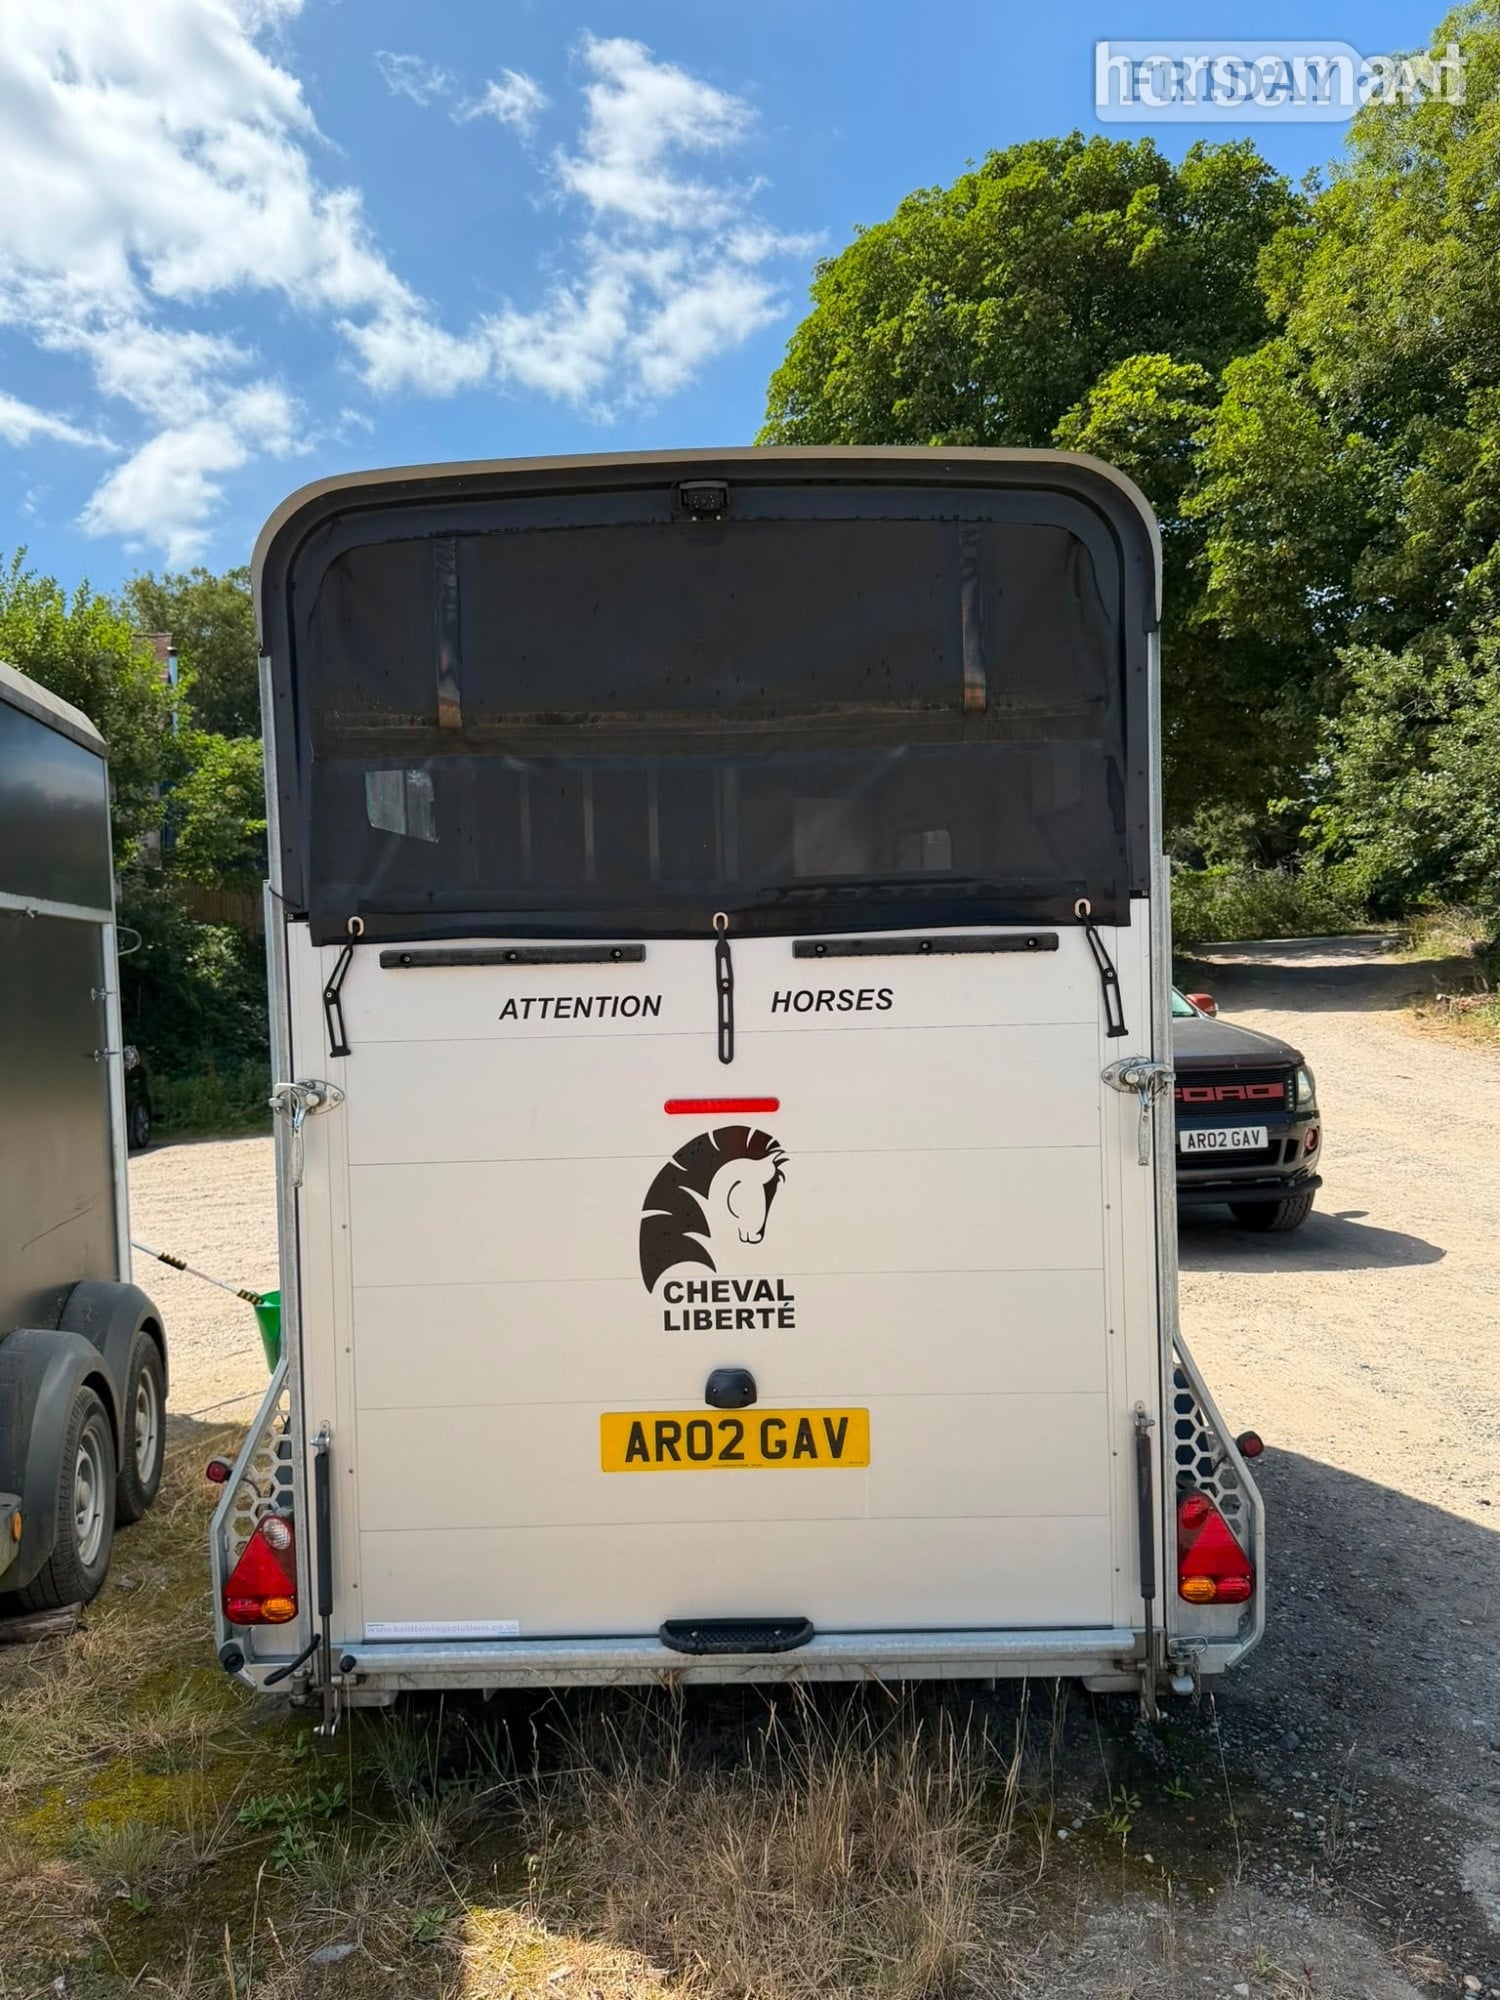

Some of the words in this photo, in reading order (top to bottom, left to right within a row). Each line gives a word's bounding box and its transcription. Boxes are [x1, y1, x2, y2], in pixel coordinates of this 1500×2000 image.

[499, 995, 662, 1020] ATTENTION
[771, 988, 894, 1013] HORSES
[1187, 1132, 1227, 1149] AR02
[1231, 1130, 1260, 1146] GAV
[663, 1279, 795, 1304] CHEVAL
[664, 1303, 796, 1331] LIBERTÉ
[625, 1419, 745, 1462] AR02
[760, 1417, 849, 1460] GAV
